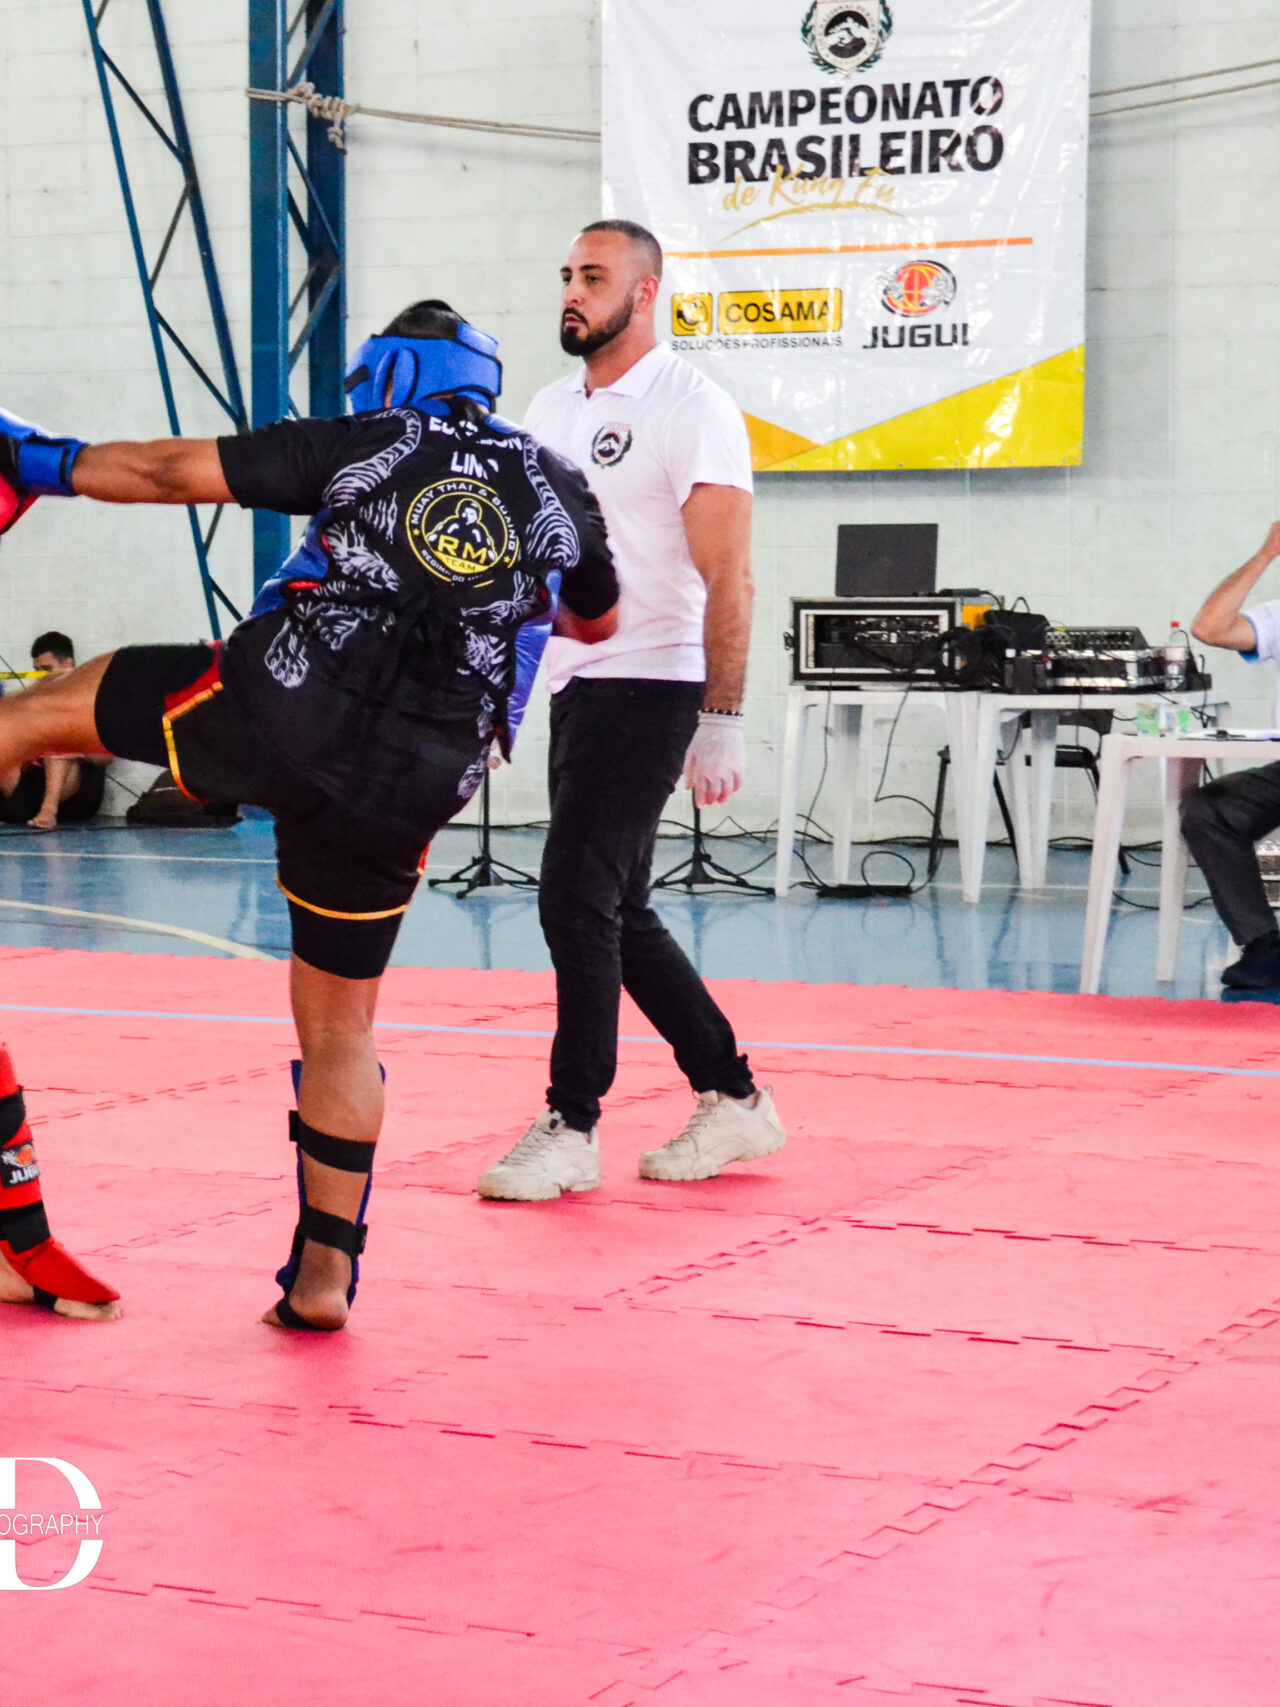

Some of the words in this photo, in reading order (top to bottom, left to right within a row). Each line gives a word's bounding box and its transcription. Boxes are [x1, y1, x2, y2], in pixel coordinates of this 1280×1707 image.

[688, 76, 1004, 132] CAMPEONATO
[688, 125, 1004, 185] BRASILEIRO
[723, 176, 759, 211] de
[770, 162, 846, 206] Kung
[854, 166, 897, 203] Fu
[726, 301, 832, 323] COSAMA
[862, 323, 969, 349] JUGUI
[411, 489, 435, 525] MUAY
[437, 482, 473, 492] THAI
[437, 534, 488, 564] RM
[445, 557, 476, 572] TEAM
